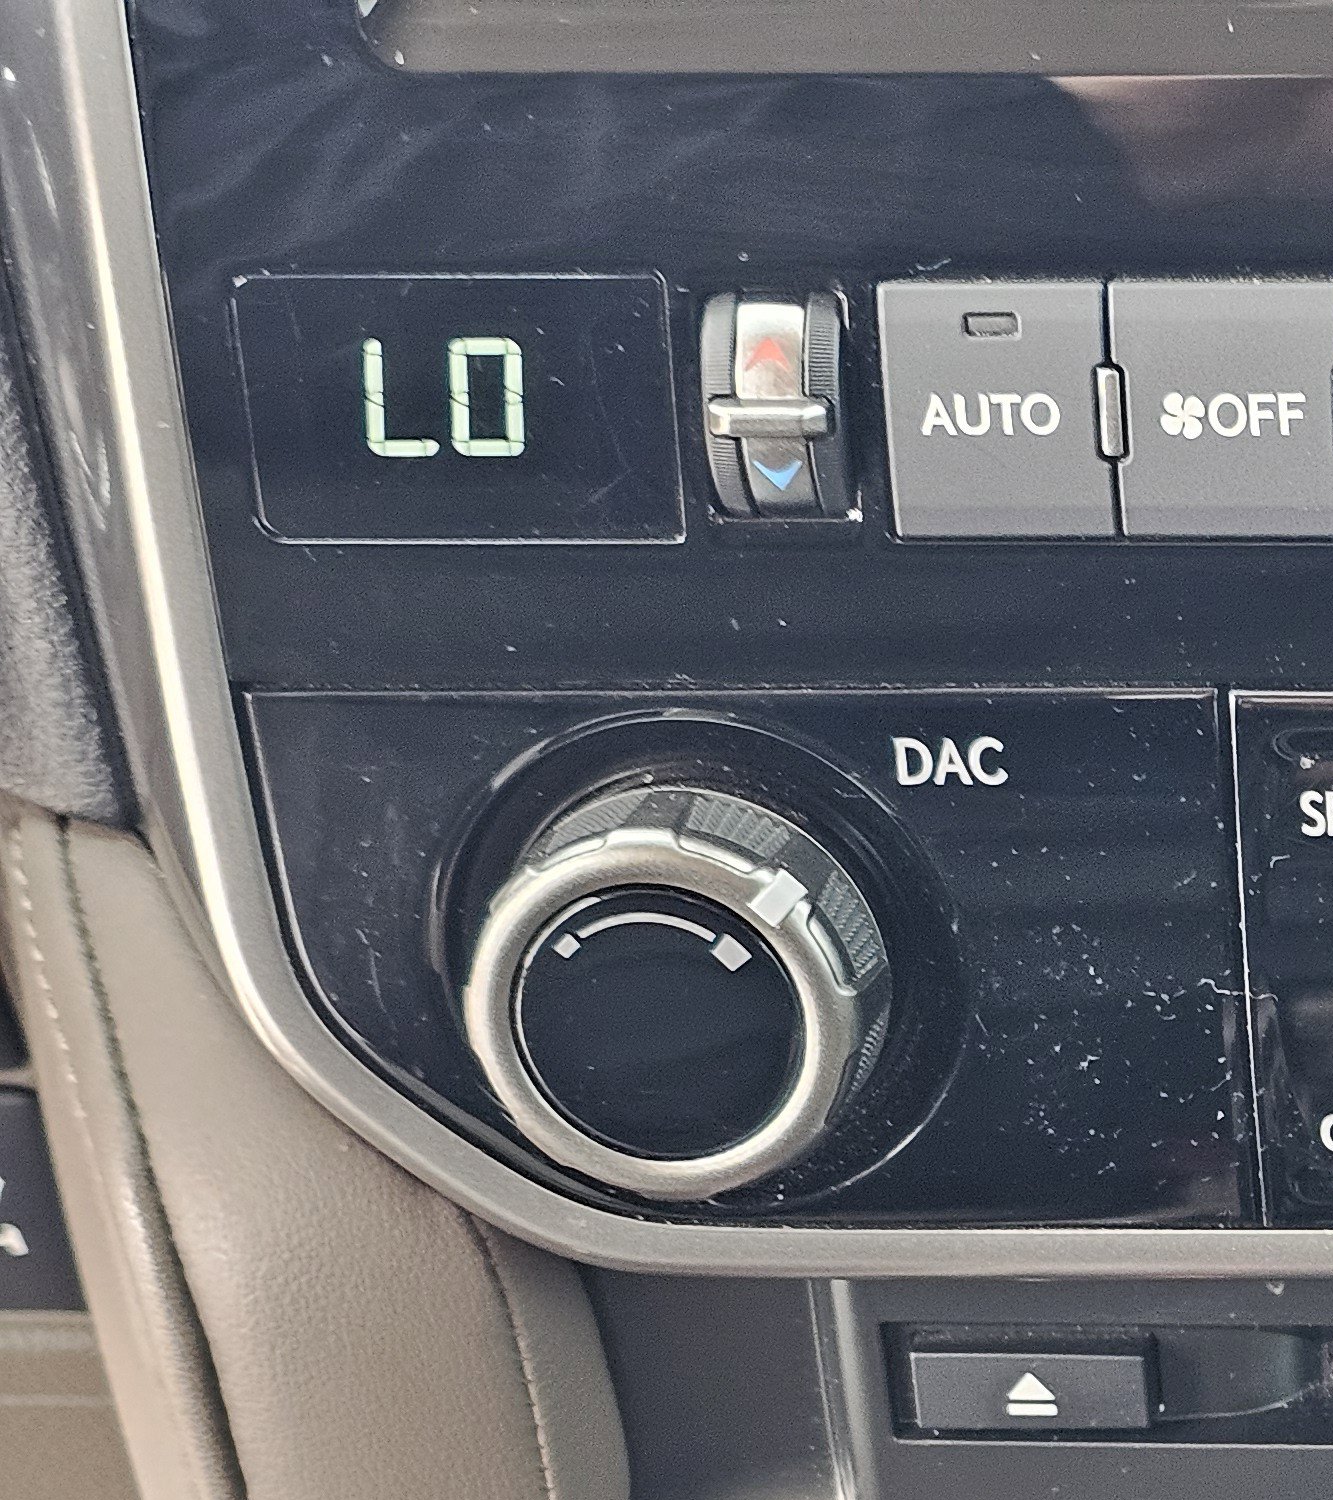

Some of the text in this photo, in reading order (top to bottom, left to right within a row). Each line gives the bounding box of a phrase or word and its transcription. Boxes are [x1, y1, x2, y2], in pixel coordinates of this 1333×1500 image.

[920, 392, 1061, 436] AUTO
[1208, 392, 1306, 437] OFF
[891, 735, 1009, 786] DAC
